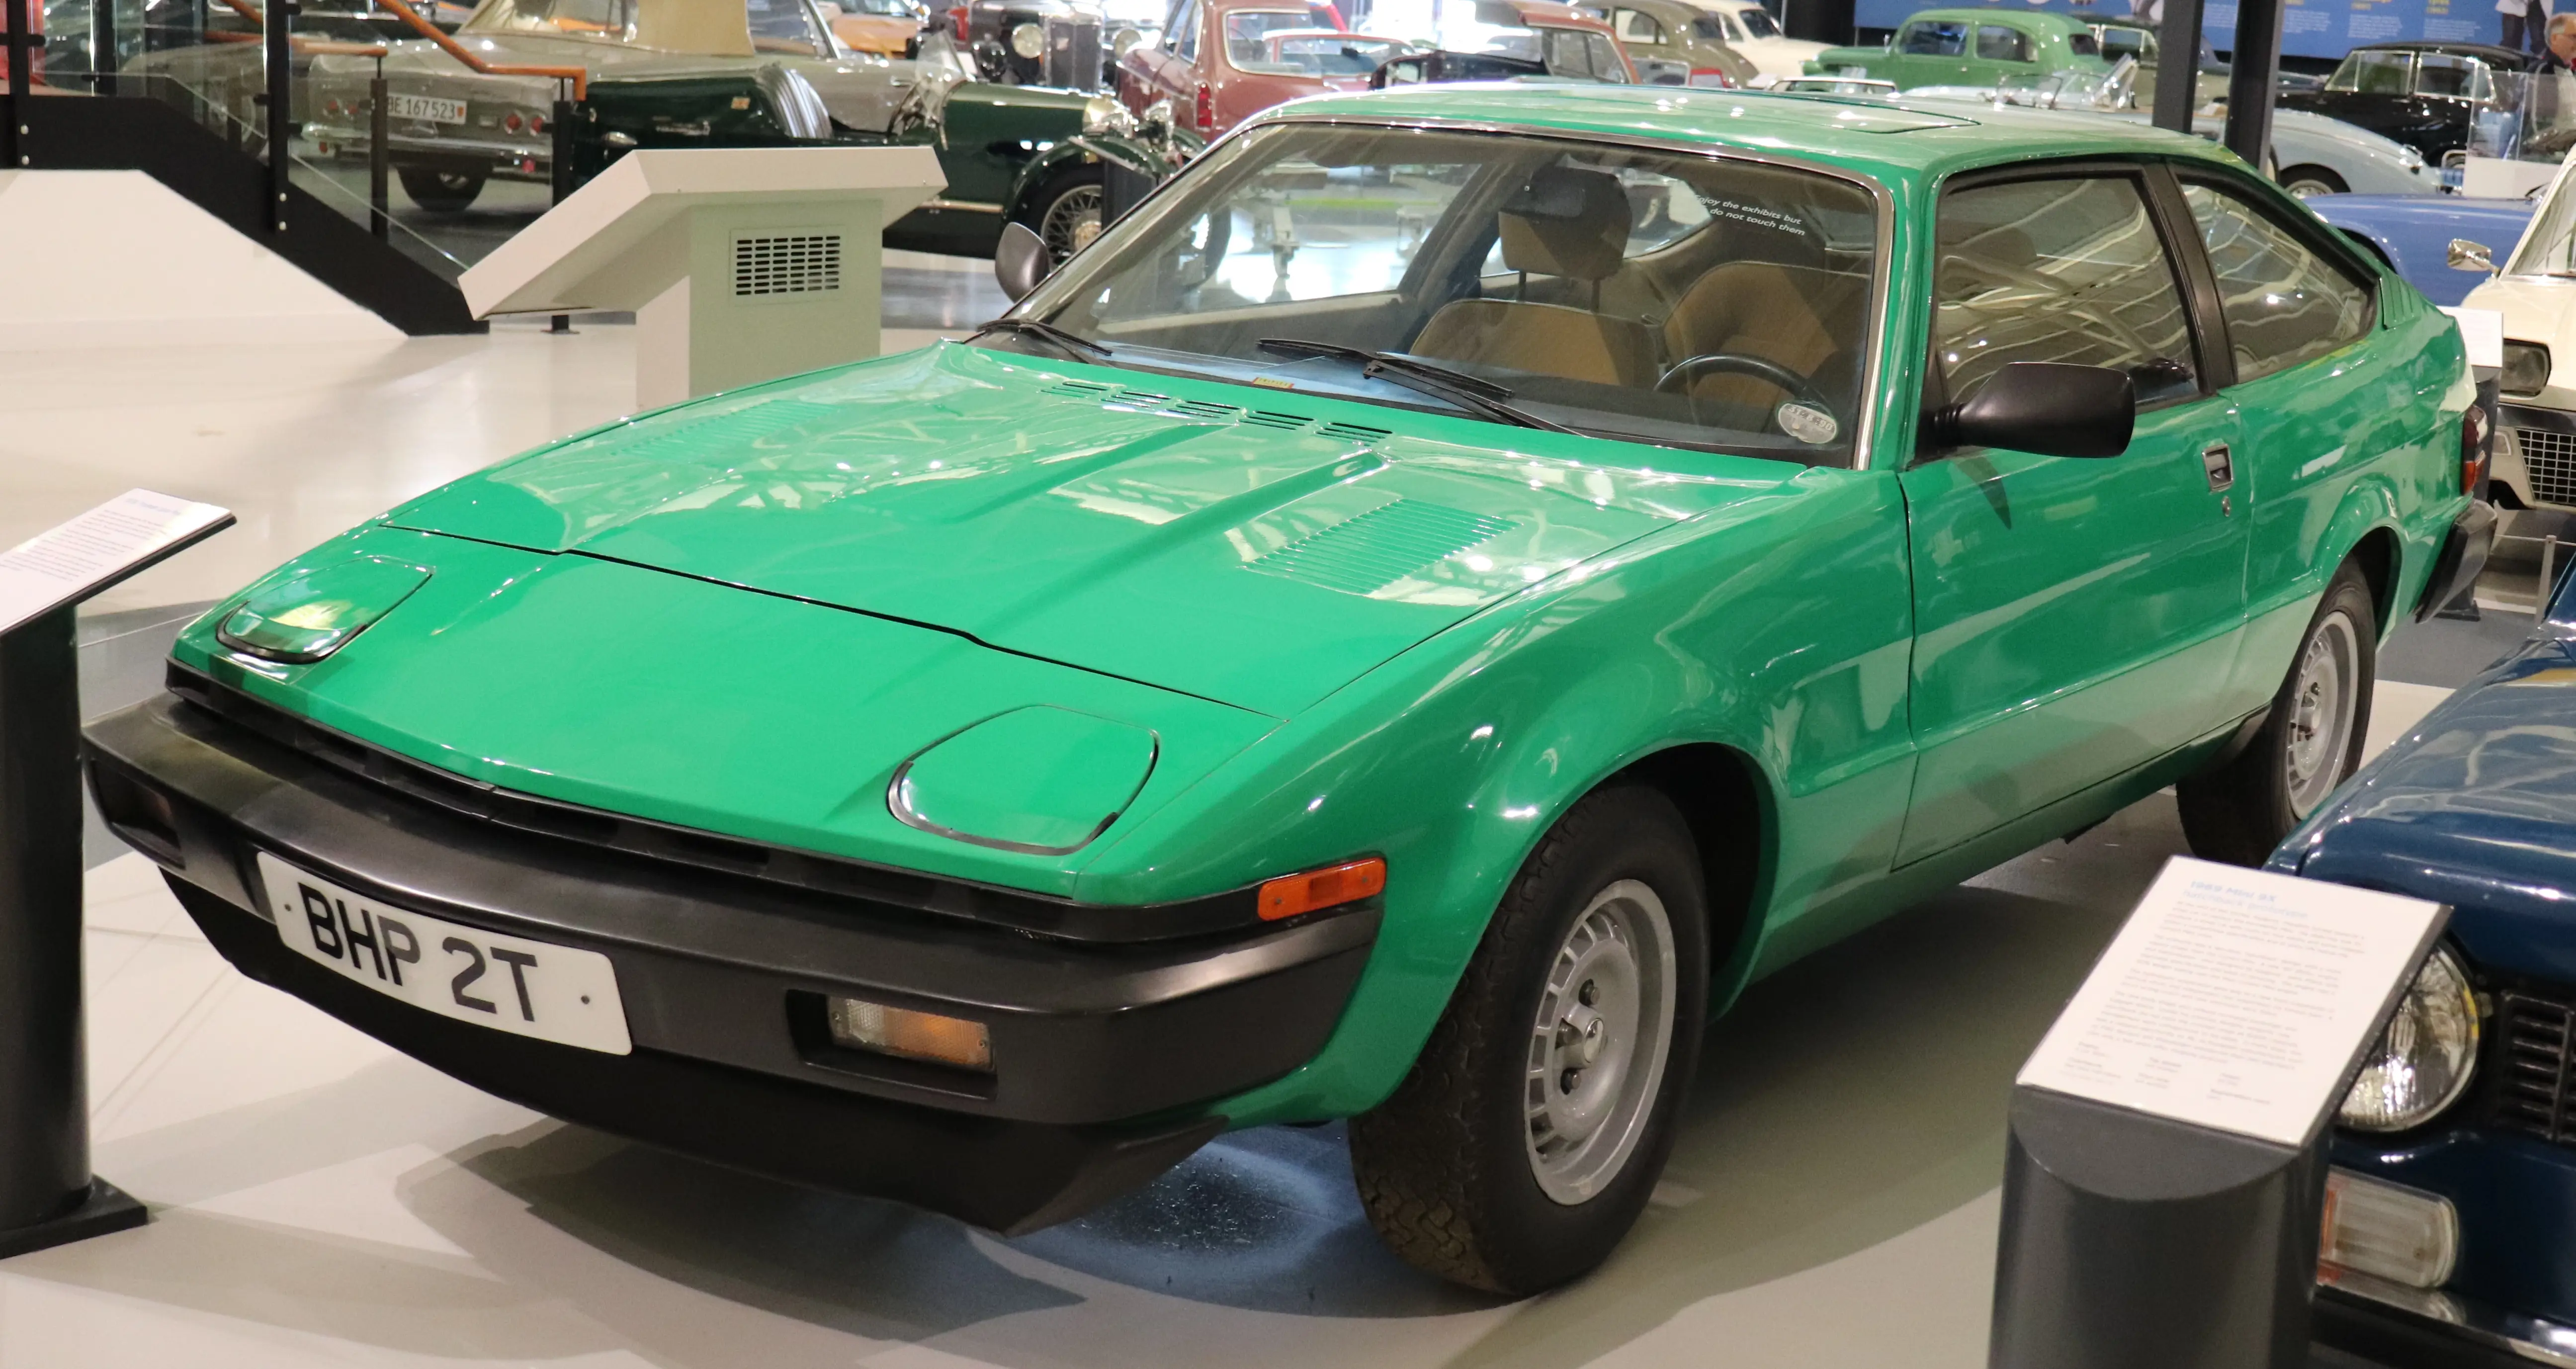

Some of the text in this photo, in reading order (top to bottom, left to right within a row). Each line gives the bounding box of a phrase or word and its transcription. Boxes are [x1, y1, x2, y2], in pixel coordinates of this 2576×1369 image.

[1722, 201, 1739, 209] the
[1741, 206, 1781, 219] exhibits
[1784, 214, 1803, 225] but
[1746, 216, 1776, 228] touch
[1779, 224, 1805, 236] them
[298, 882, 538, 1022] BHP 2T
